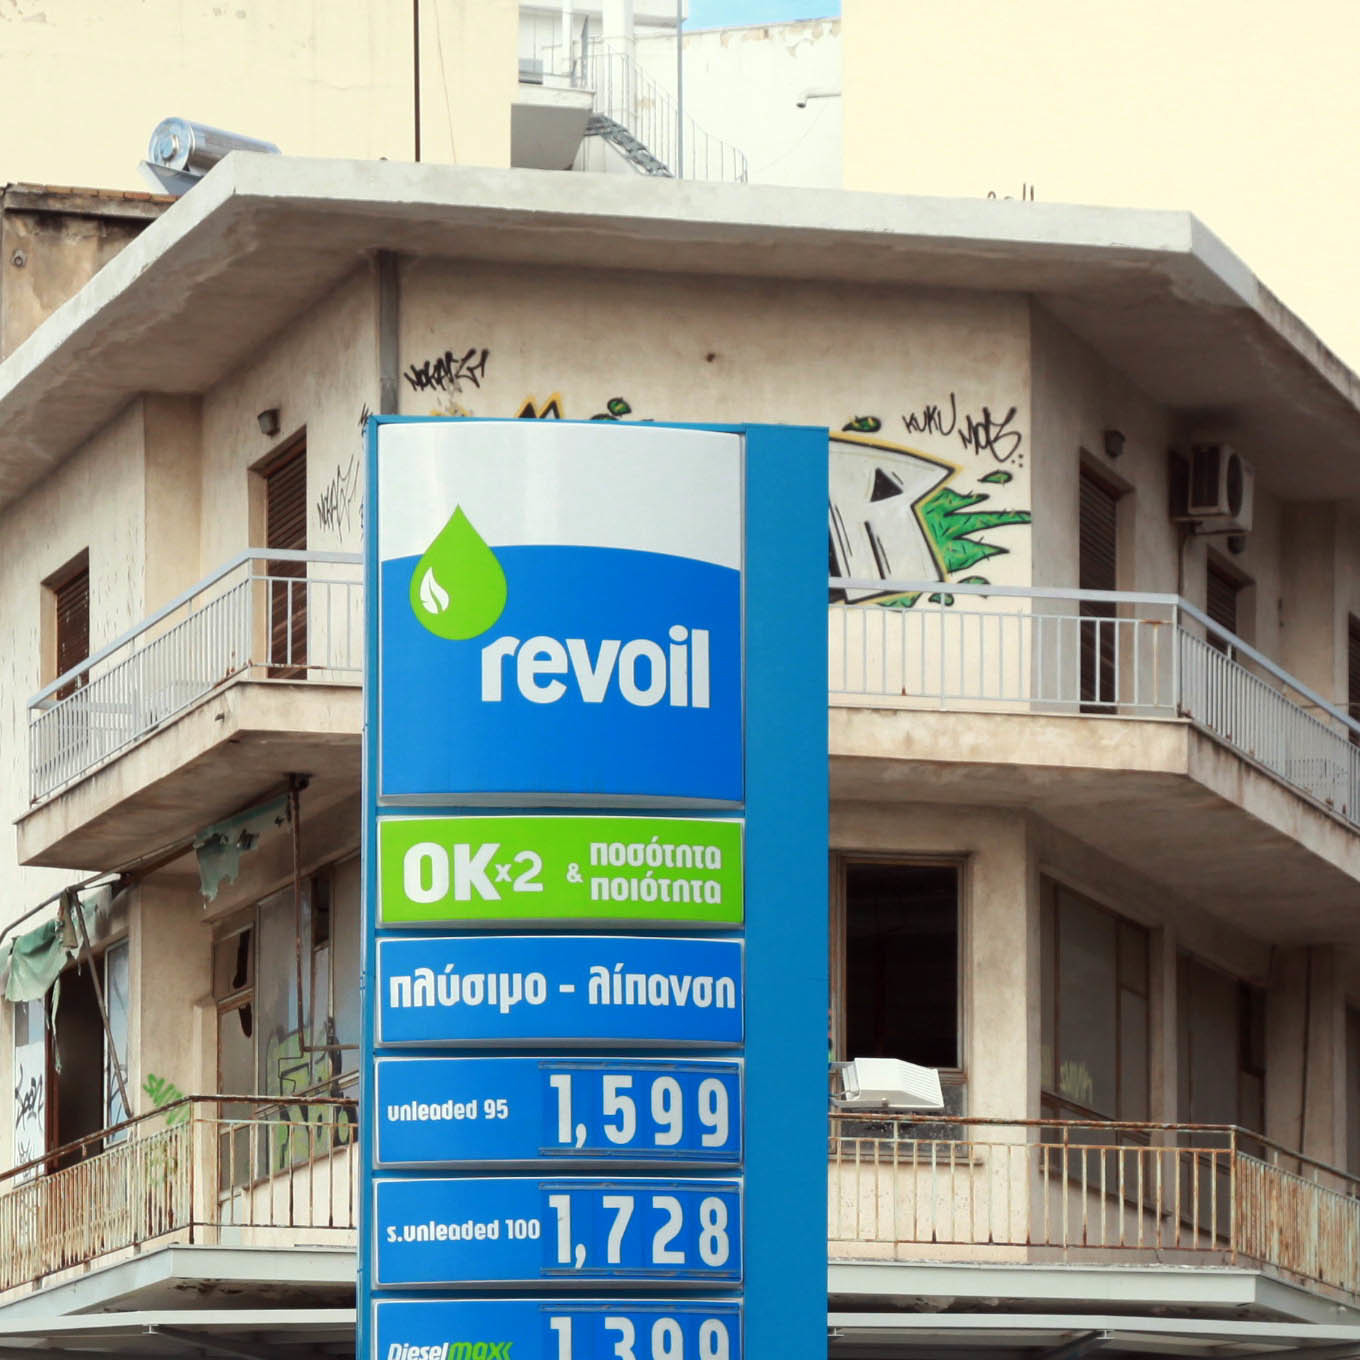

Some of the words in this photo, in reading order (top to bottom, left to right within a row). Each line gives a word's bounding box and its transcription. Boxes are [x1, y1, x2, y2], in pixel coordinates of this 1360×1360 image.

[481, 624, 710, 708] revoil
[566, 863, 583, 883] &
[590, 836, 722, 869] ποσότητα
[591, 871, 722, 904] ποιότητα
[389, 964, 547, 1014] πλύσιμο
[588, 963, 736, 1009] λίπανση
[388, 1100, 477, 1122] unleaded
[484, 1099, 509, 1120] 95
[549, 1074, 730, 1149] 1,599
[387, 1219, 499, 1243] s.unleaded
[507, 1219, 541, 1240] 100
[548, 1194, 731, 1269] 1,728
